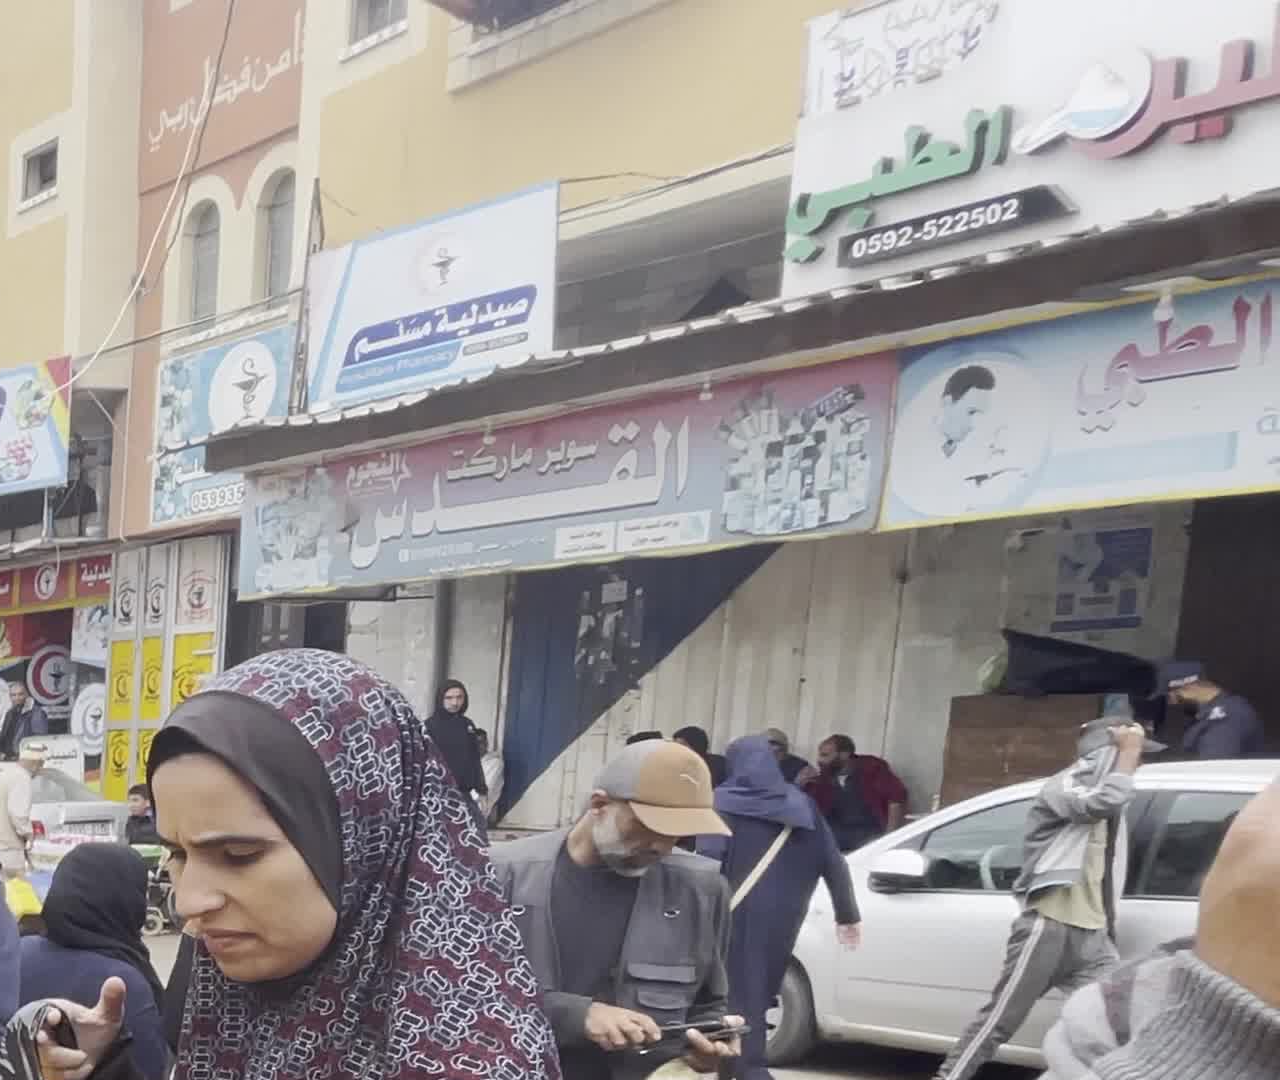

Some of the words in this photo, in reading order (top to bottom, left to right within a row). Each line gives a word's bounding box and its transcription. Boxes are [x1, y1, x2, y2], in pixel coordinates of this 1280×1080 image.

[783, 105, 1016, 263] الطبي
[850, 197, 1019, 260] 0592-522502
[434, 297, 529, 337] صيدلية
[446, 438, 534, 481] ماركت
